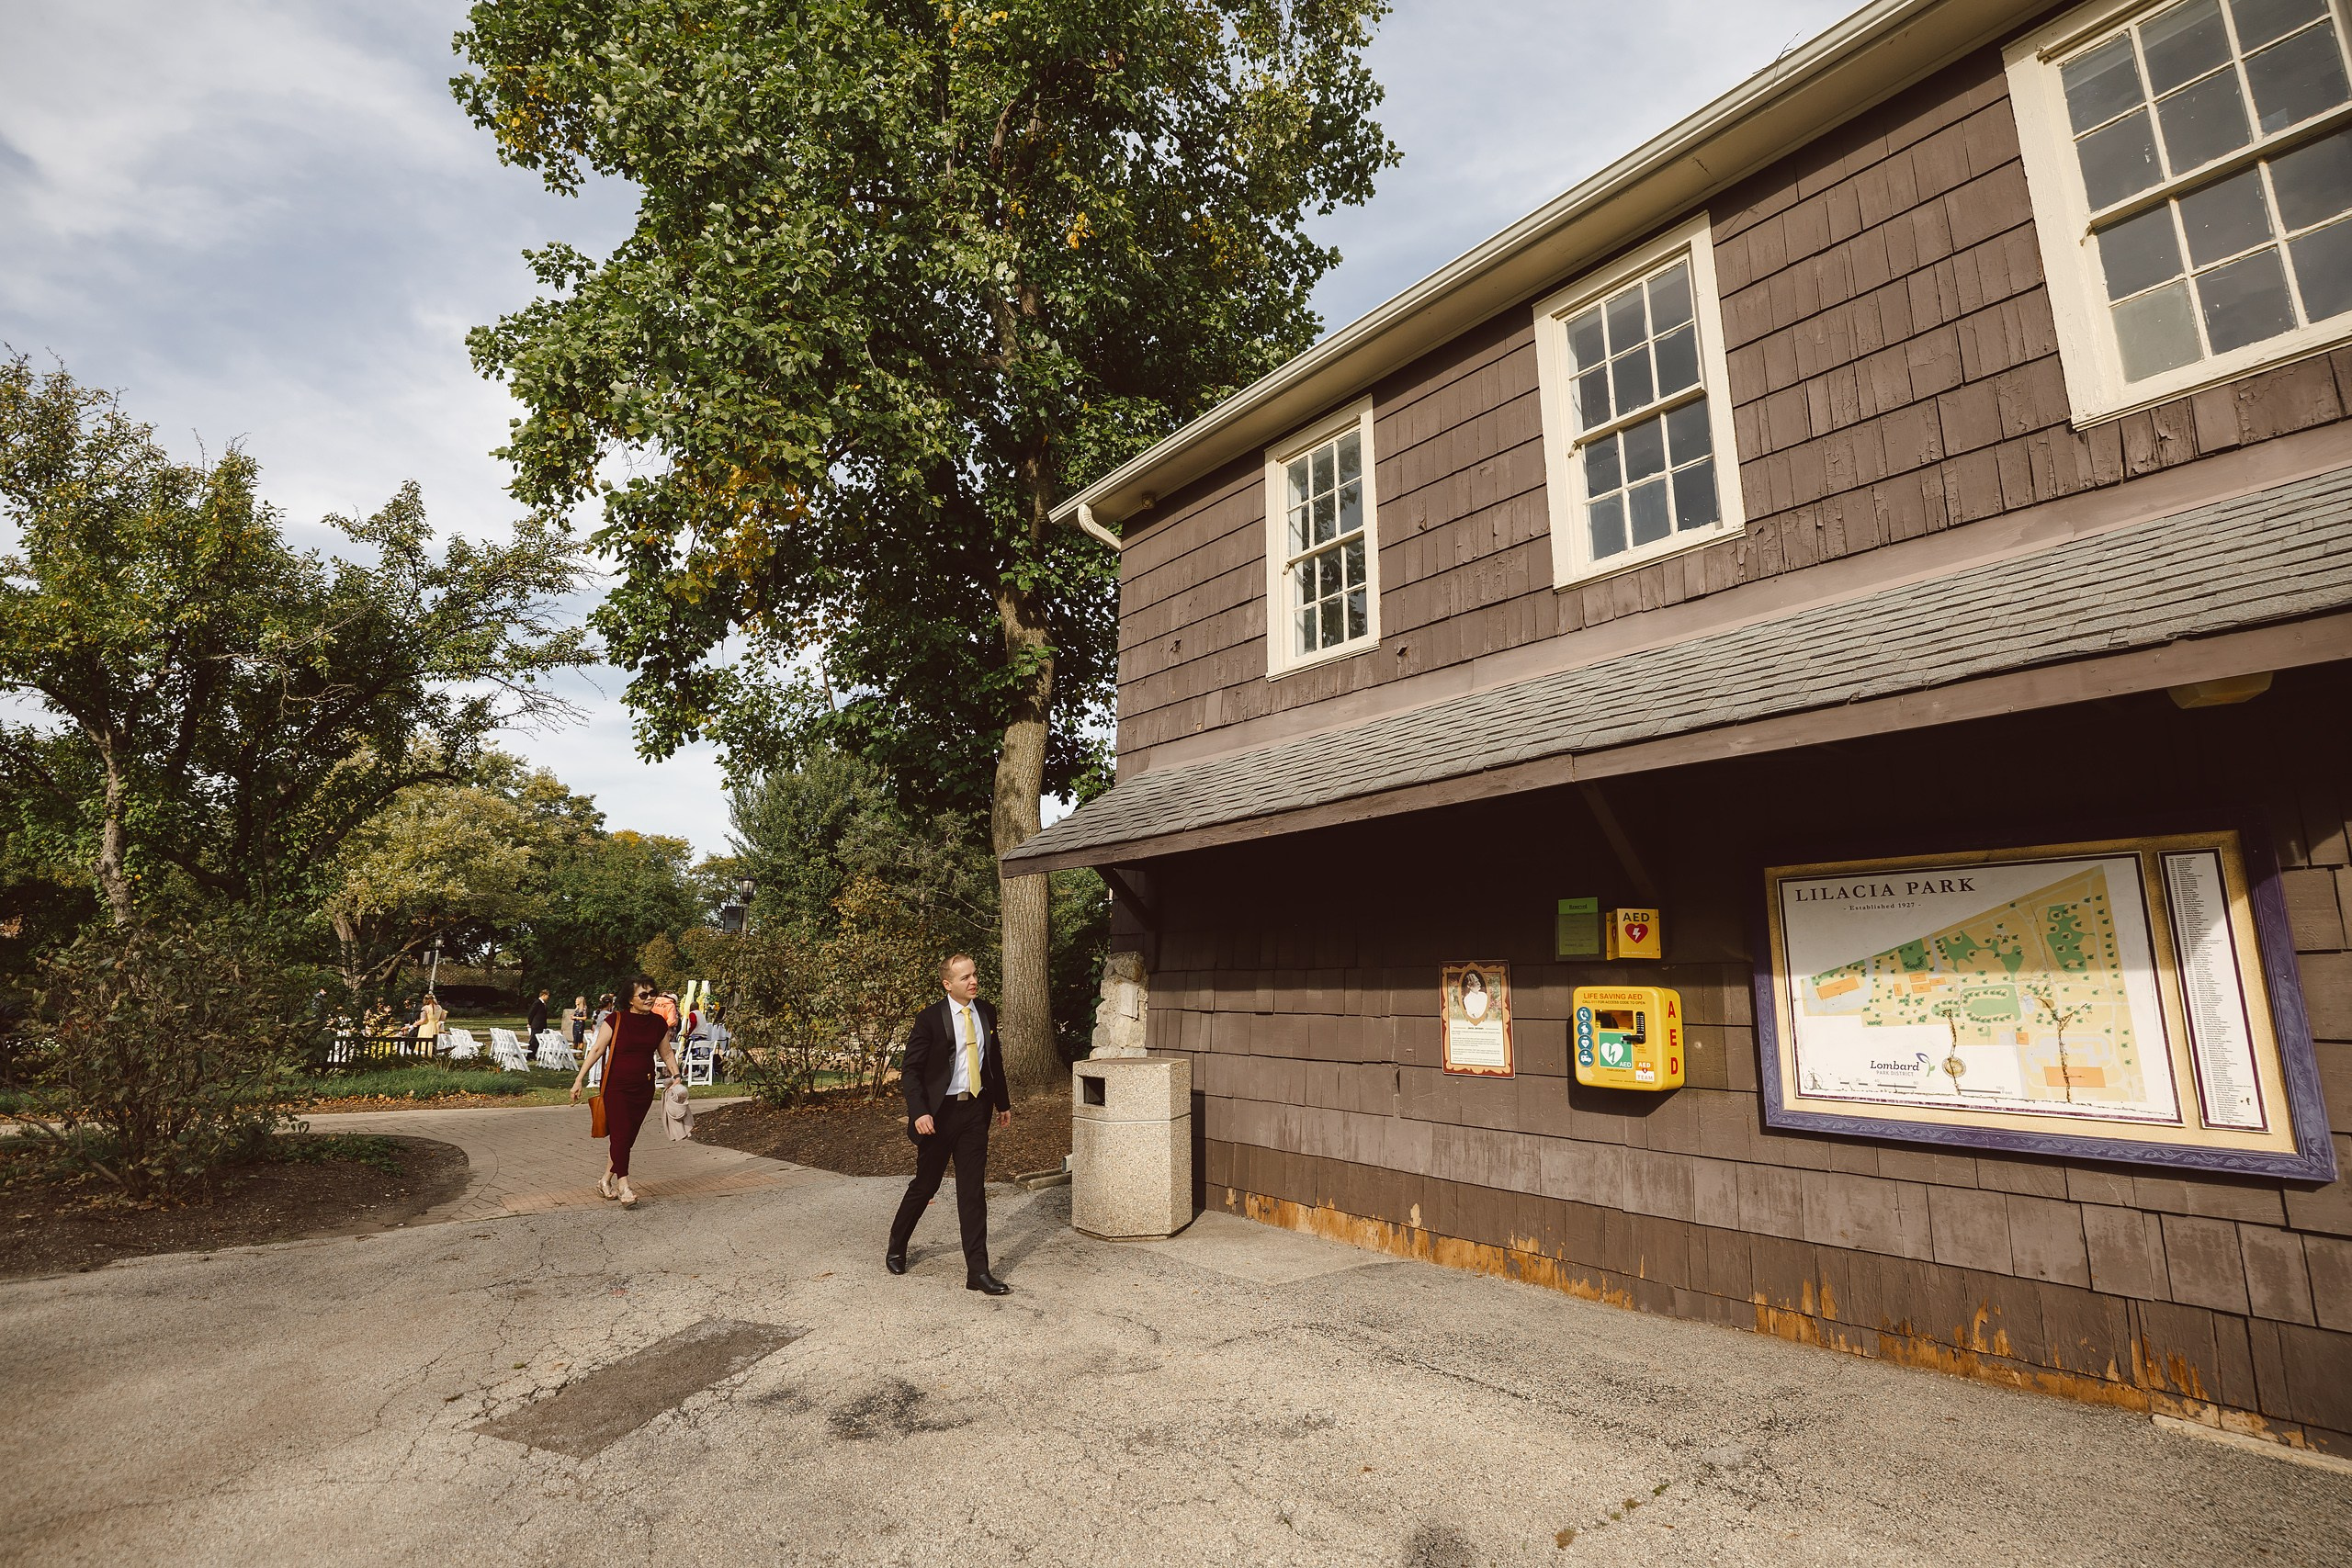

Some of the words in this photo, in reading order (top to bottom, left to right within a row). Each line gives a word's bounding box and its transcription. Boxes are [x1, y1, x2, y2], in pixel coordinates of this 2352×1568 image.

[1795, 883, 1895, 902] LILACIA
[1905, 877, 1976, 896] PARK
[1849, 903, 1895, 911] Established
[1623, 912, 1650, 922] AED
[1870, 1060, 1920, 1072] Lombard
